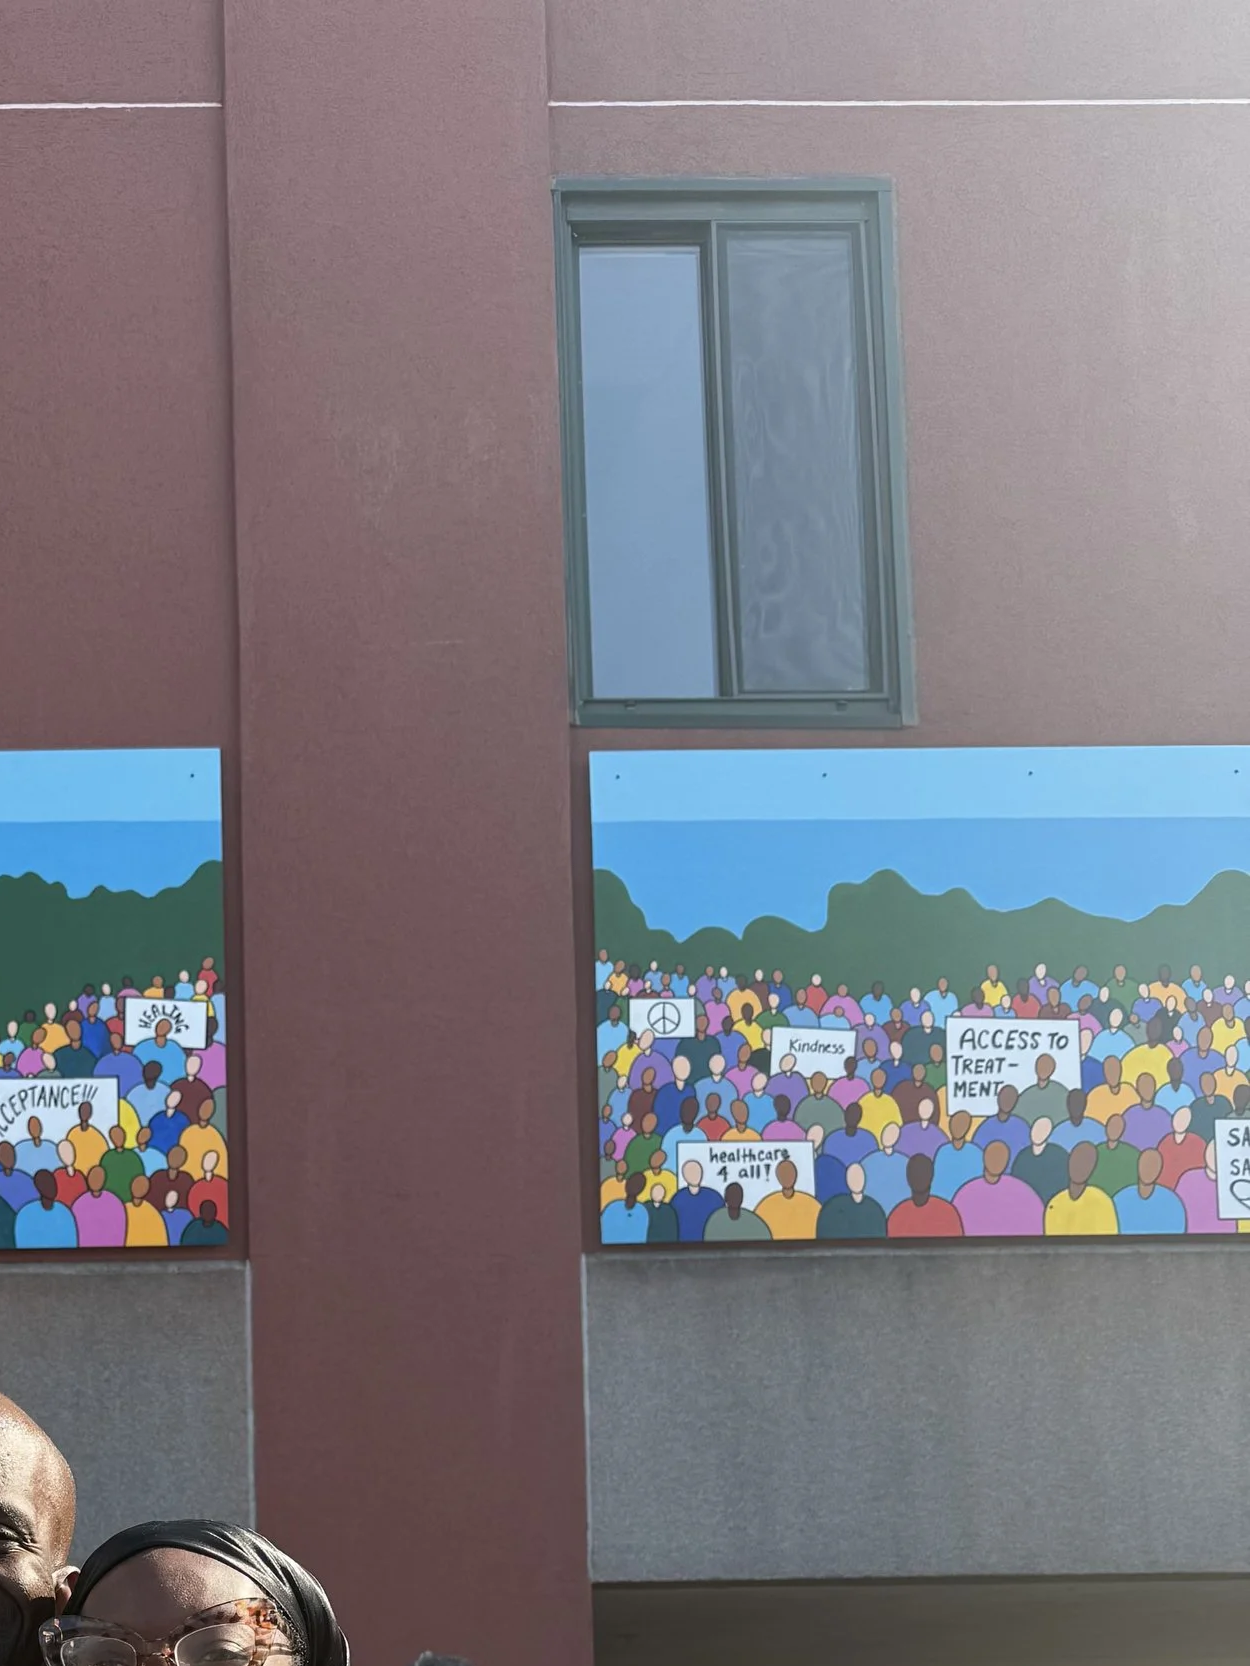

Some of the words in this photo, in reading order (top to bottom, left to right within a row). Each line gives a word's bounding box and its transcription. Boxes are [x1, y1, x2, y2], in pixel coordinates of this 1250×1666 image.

[138, 1004, 190, 1034] HEALING
[789, 1038, 845, 1055] Kindness
[959, 1027, 1040, 1050] ACCESS
[953, 1081, 1004, 1098] MENT
[709, 1147, 790, 1163] healthcare
[717, 1166, 729, 1183] 4
